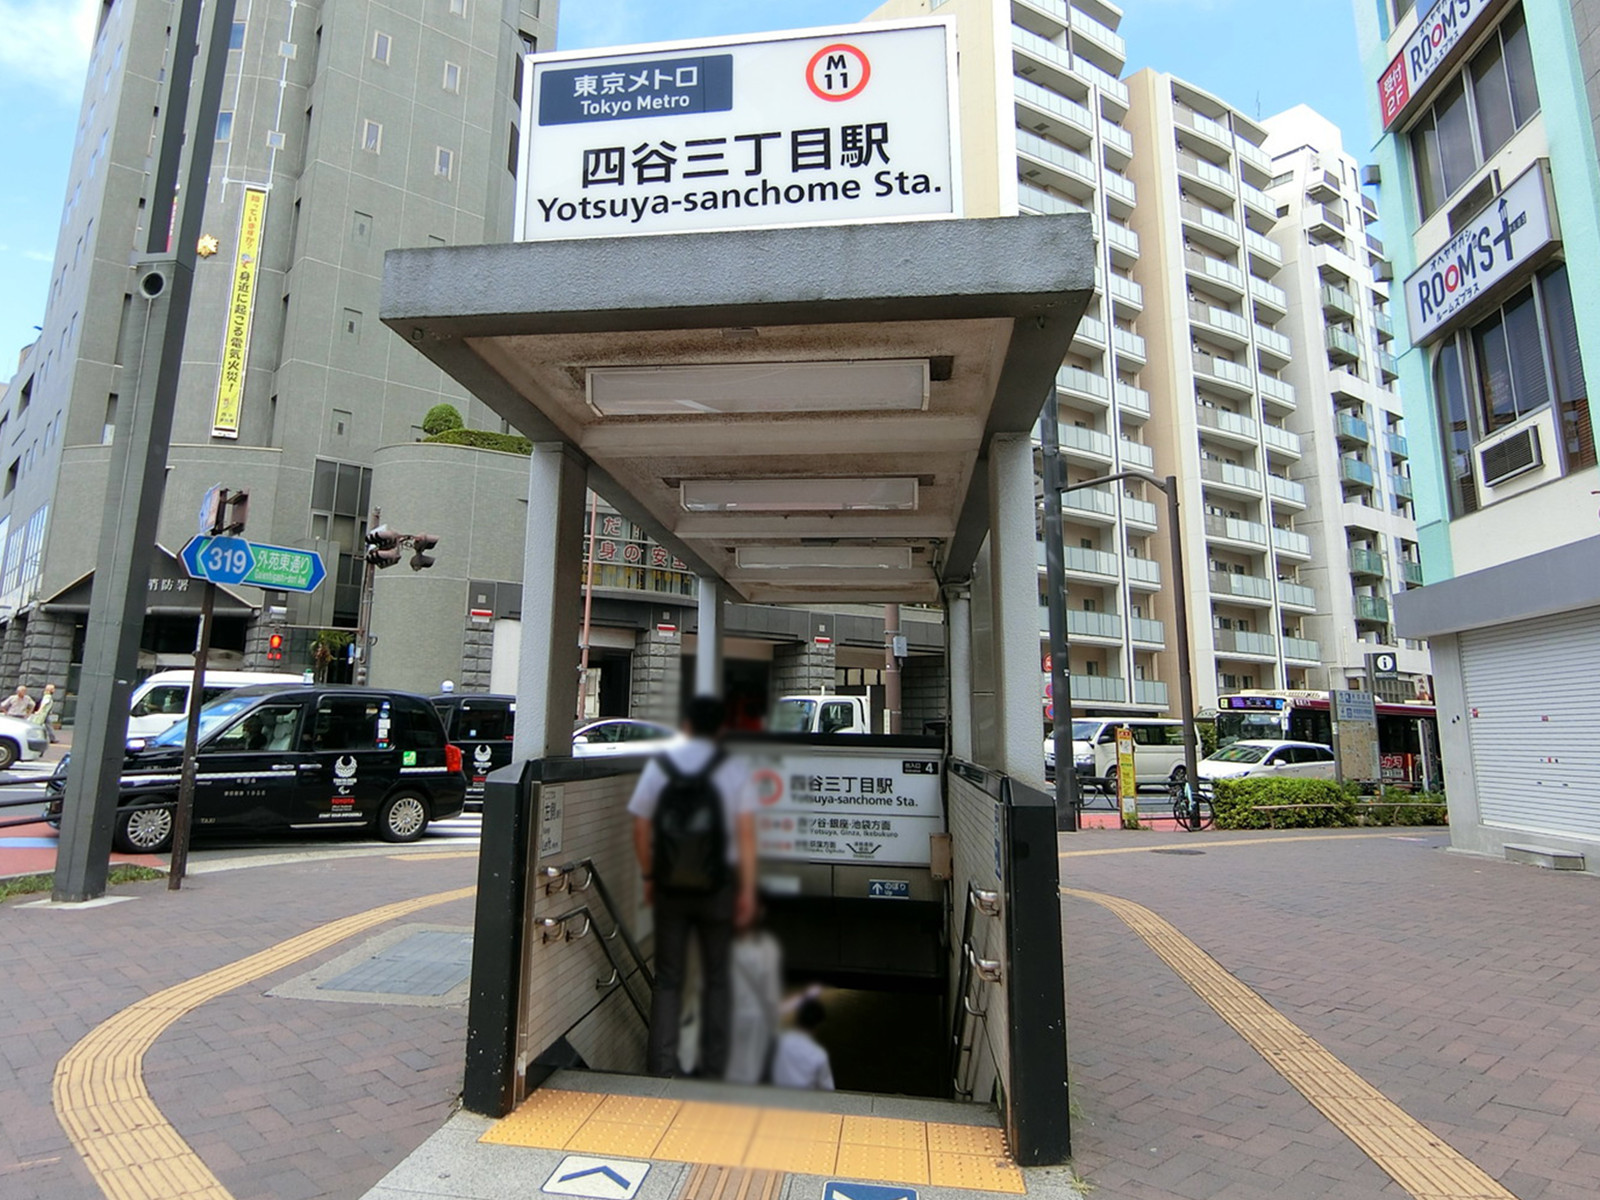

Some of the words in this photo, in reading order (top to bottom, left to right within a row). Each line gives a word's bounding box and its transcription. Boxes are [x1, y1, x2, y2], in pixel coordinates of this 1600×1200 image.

[826, 54, 848, 70] M
[572, 65, 699, 98] 東京メトロ
[824, 72, 849, 91] 11
[1383, 63, 1402, 92] 受付
[580, 99, 633, 119] Tokyo
[636, 93, 691, 111] Metro
[1385, 89, 1404, 117] 2F
[582, 121, 892, 189] 四谷三丁目駅
[537, 176, 861, 224] Yotsuya-sanchome
[874, 170, 942, 198] Sta.
[208, 547, 247, 575] 319
[257, 550, 310, 575] 外苑東通り
[925, 762, 934, 774] 4
[896, 796, 919, 807] Sta.
[798, 818, 892, 831] ツ谷・銀座・池袋方面
[884, 883, 907, 891] のぼり
